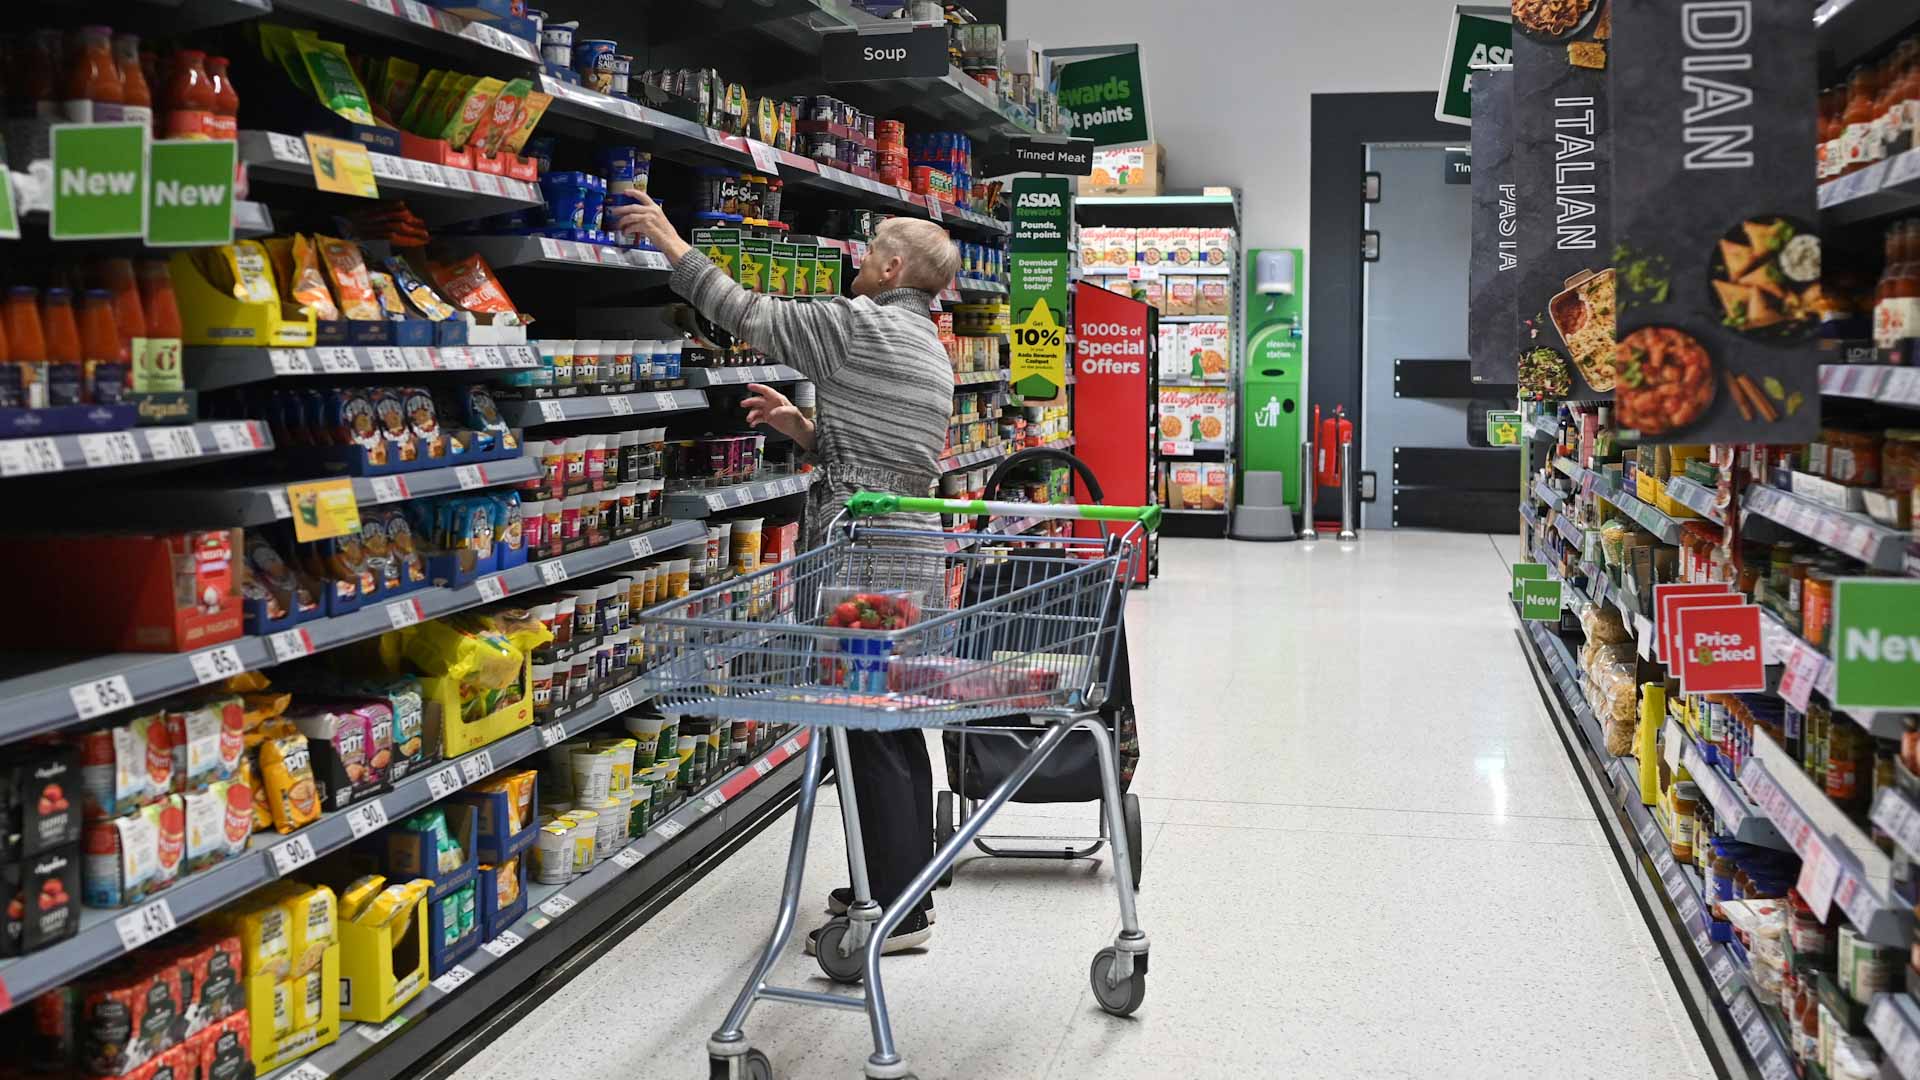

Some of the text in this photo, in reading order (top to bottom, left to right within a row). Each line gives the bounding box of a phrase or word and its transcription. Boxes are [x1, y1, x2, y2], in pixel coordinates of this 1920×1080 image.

[864, 47, 907, 62] Soup
[1058, 76, 1131, 106] ewards
[1682, 0, 1754, 169] DIAN
[1083, 104, 1134, 130] points
[1016, 149, 1086, 164] Tinned Meat
[1454, 163, 1471, 173] Tin
[1555, 97, 1596, 249] ITALIAN
[60, 168, 136, 197] New
[155, 180, 226, 208] New
[1016, 193, 1062, 208] ASDA
[1016, 207, 1062, 217] Rewards
[1021, 221, 1057, 231] Pounds,
[1499, 184, 1517, 271] PASTA
[1016, 231, 1061, 240] not points
[1014, 328, 1060, 346] 10%
[1081, 323, 1142, 336] 1000s of
[1078, 340, 1144, 356] Special
[1266, 350, 1291, 358] station
[1082, 359, 1140, 375] Offers
[1526, 593, 1557, 607] New
[1695, 631, 1742, 647] Price
[1688, 645, 1756, 666] Locked
